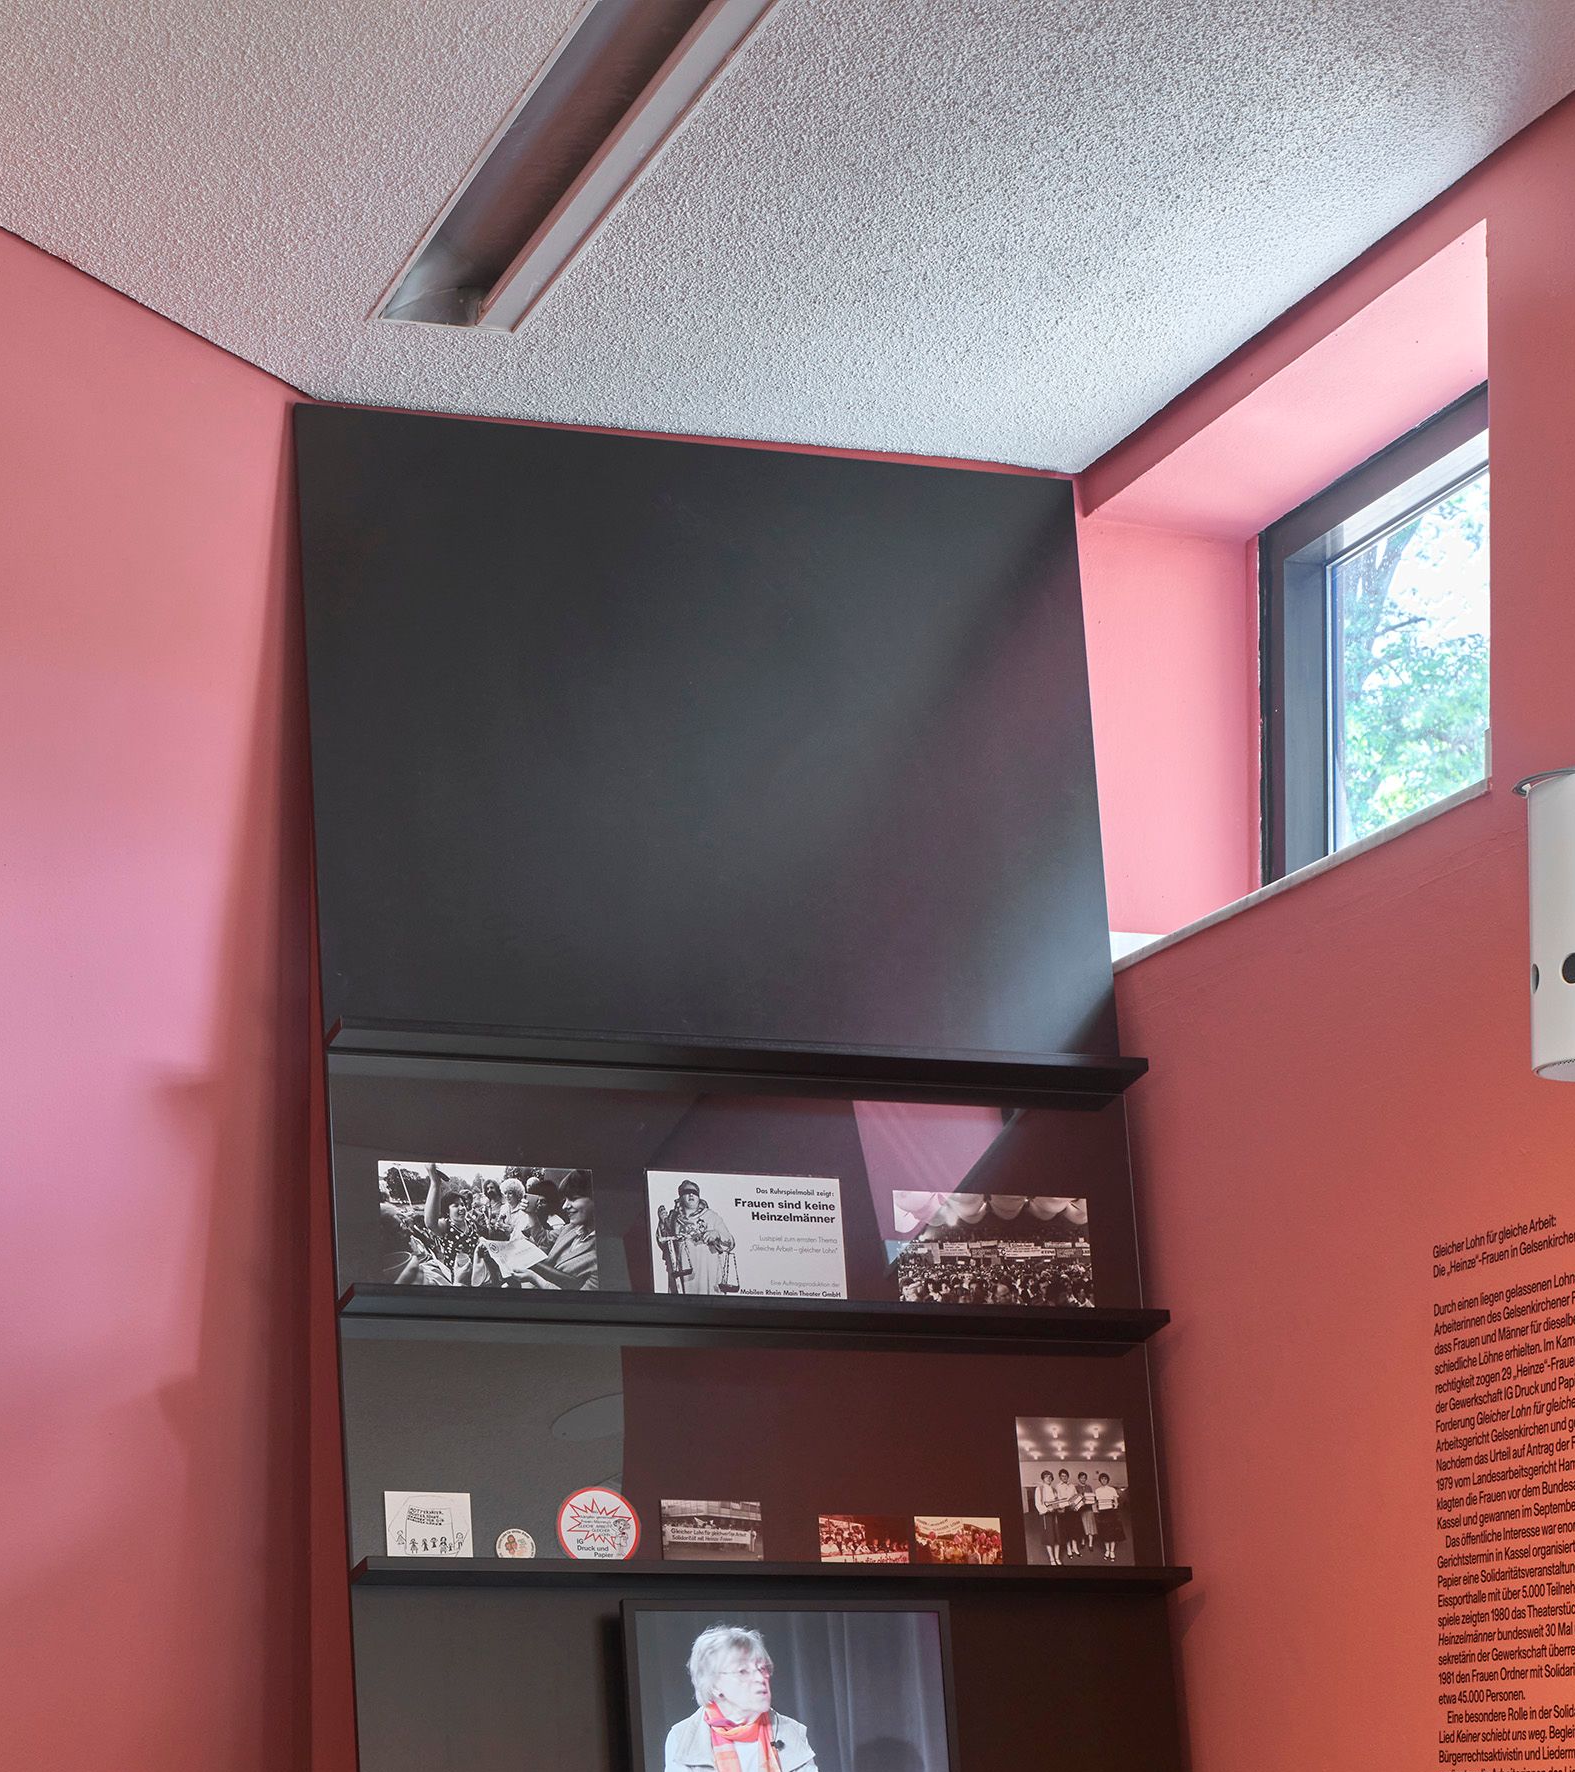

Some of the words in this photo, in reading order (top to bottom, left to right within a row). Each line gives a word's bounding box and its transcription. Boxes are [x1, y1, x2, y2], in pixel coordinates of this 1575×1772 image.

[770, 1188, 814, 1197] Ruhrspielmobil
[734, 1198, 774, 1209] Frauen
[778, 1200, 801, 1209] sind
[805, 1201, 835, 1211] keine
[752, 1211, 836, 1223] Heinzelmänner
[1431, 1239, 1465, 1259] Gleicher
[1464, 1233, 1486, 1250] Lohn
[1485, 1229, 1498, 1245] für
[1497, 1222, 1529, 1245] gleiche
[1527, 1213, 1557, 1234] Arbeit:
[1431, 1262, 1446, 1279] Die
[1509, 1243, 1519, 1258] in
[1432, 1314, 1486, 1337] Arbeiterinnen
[1485, 1309, 1502, 1324] des
[1501, 1294, 1571, 1321] Gelsenkirchener
[1436, 1572, 1462, 1591] Papier
[1461, 1570, 1480, 1586] eine
[1437, 1692, 1457, 1706] etwa
[1456, 1688, 1485, 1704] 45.000
[1484, 1687, 1526, 1703] Personen.
